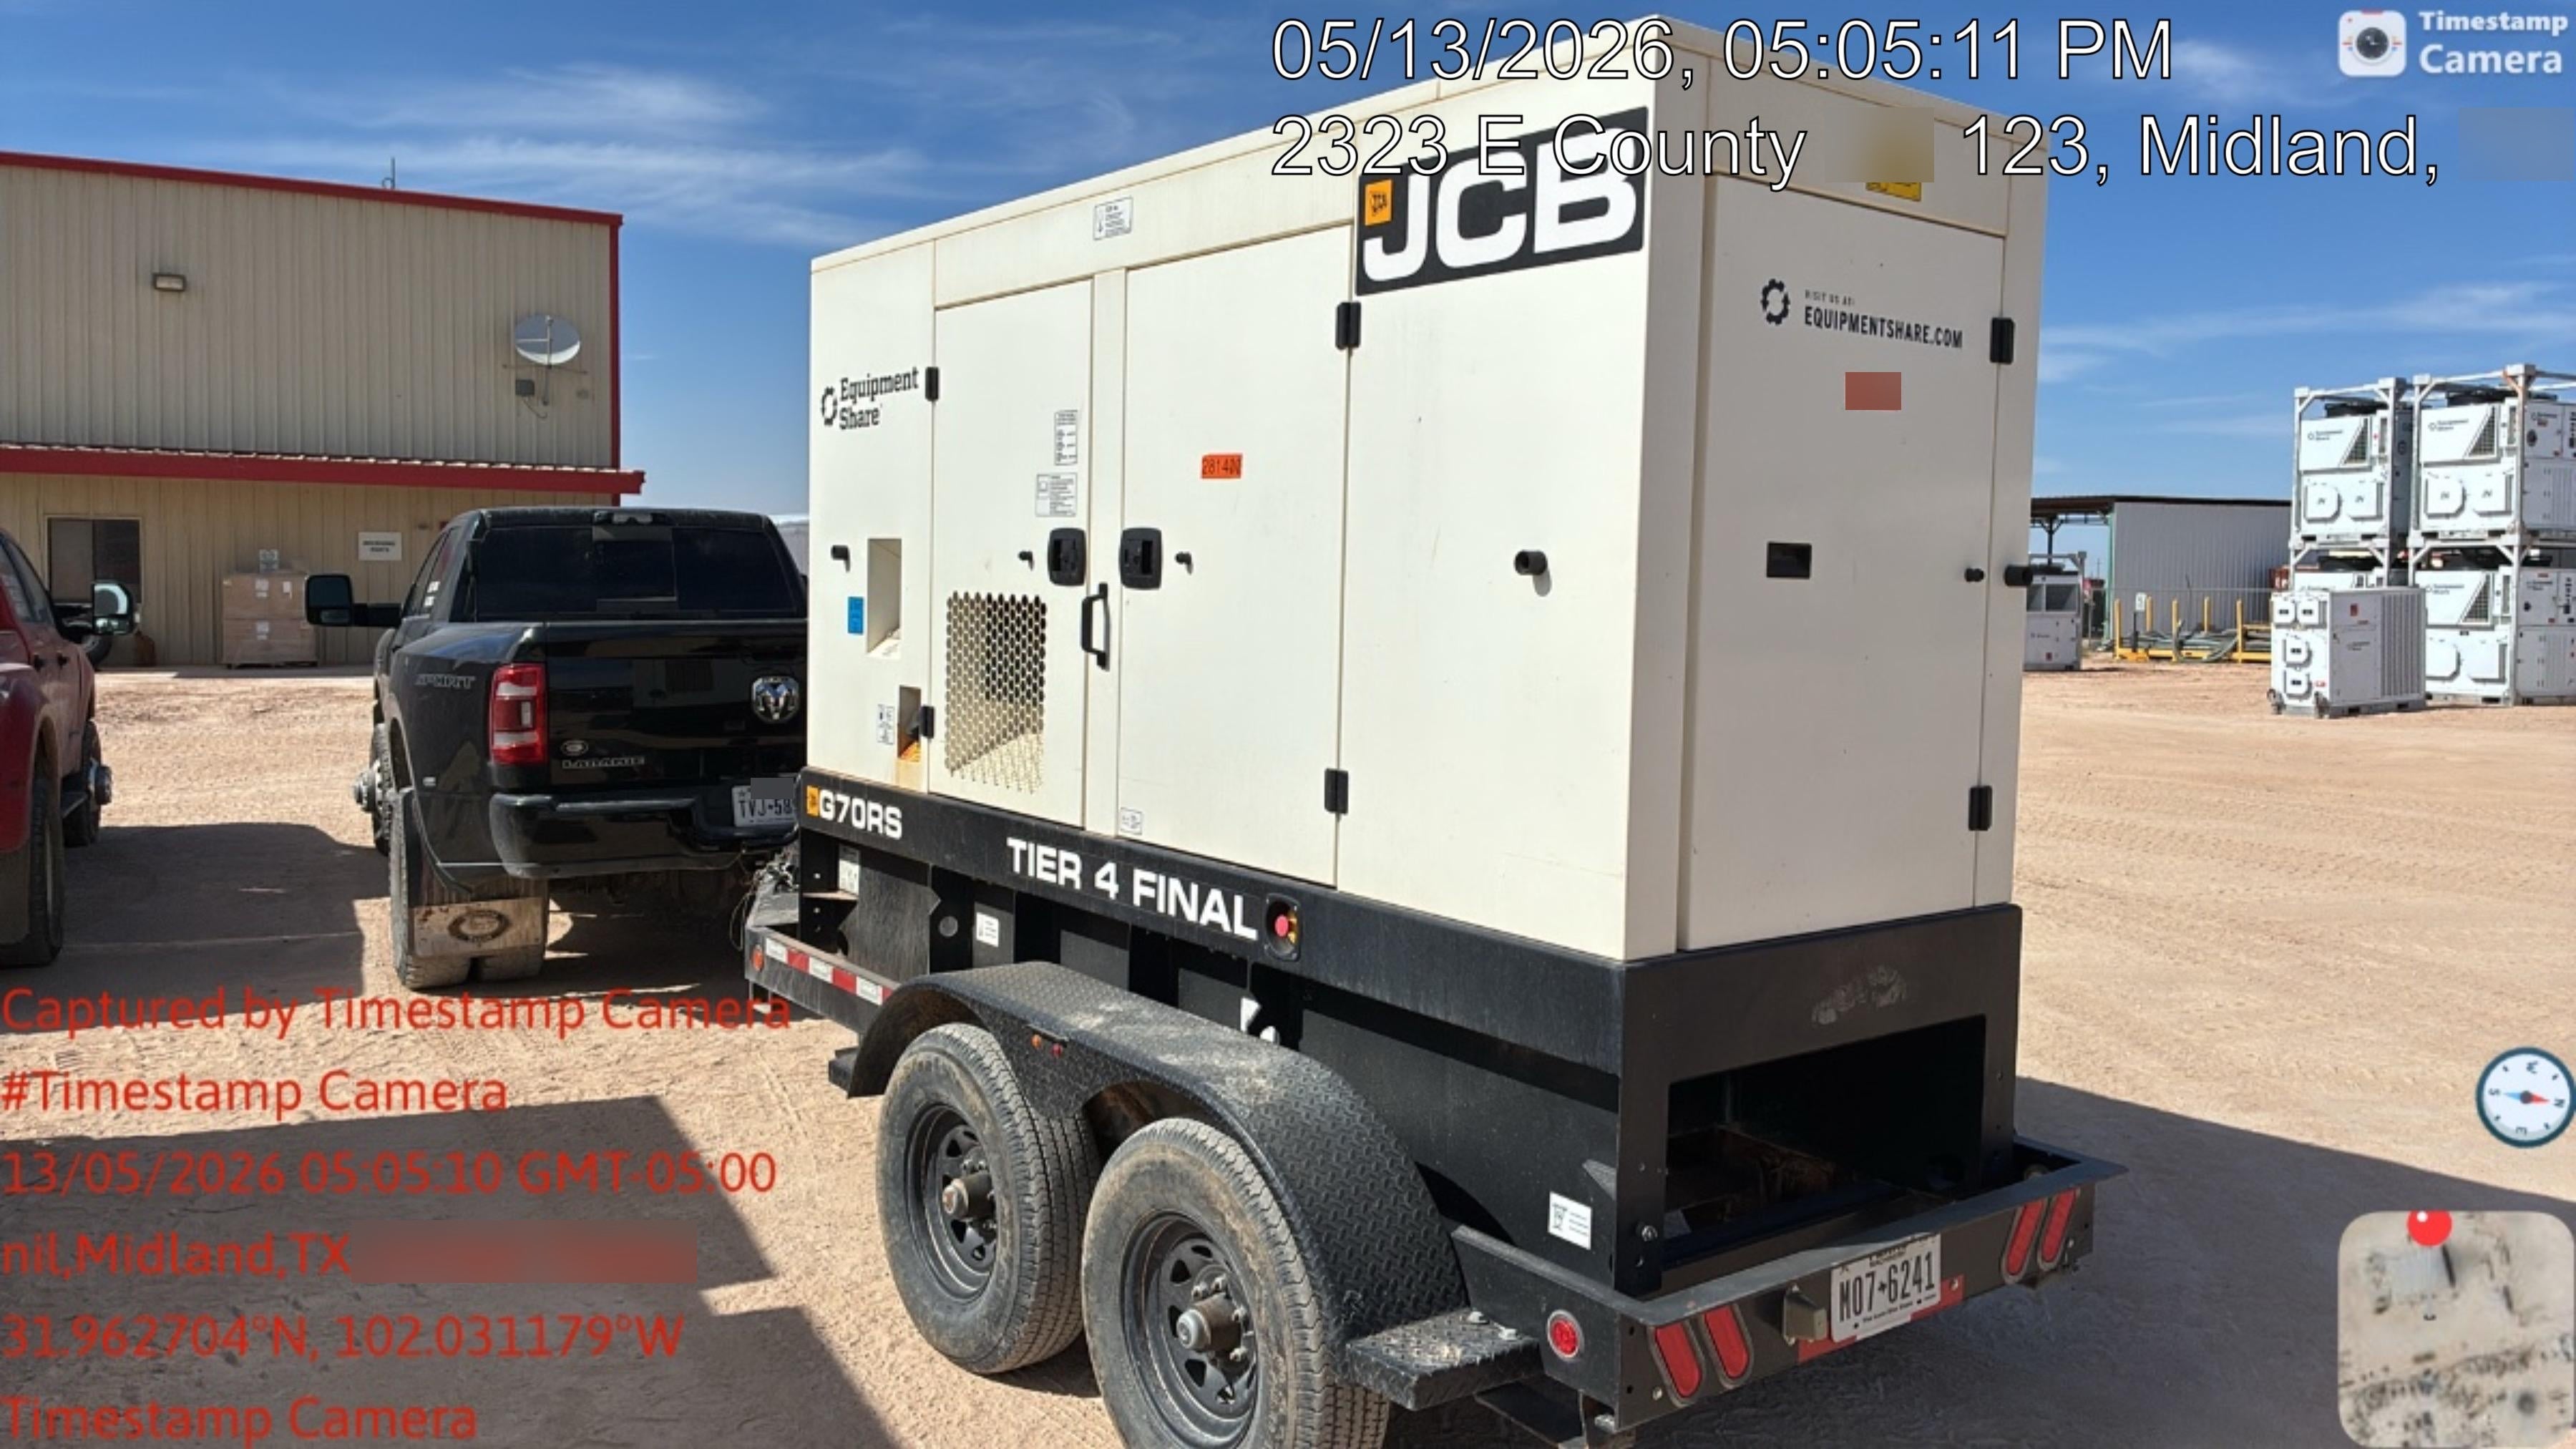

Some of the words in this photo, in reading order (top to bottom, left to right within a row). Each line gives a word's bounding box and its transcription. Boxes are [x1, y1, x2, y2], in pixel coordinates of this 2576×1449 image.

[1362, 127, 1637, 282] JCB
[1805, 306, 1963, 348] EQUIPMENTSHARE.COM
[841, 366, 919, 404] Equipment
[839, 407, 879, 429] Share
[819, 789, 902, 839] G70RS
[1006, 836, 1083, 890] TIER
[1095, 862, 1118, 900] 4
[1133, 869, 1259, 941] FINAL
